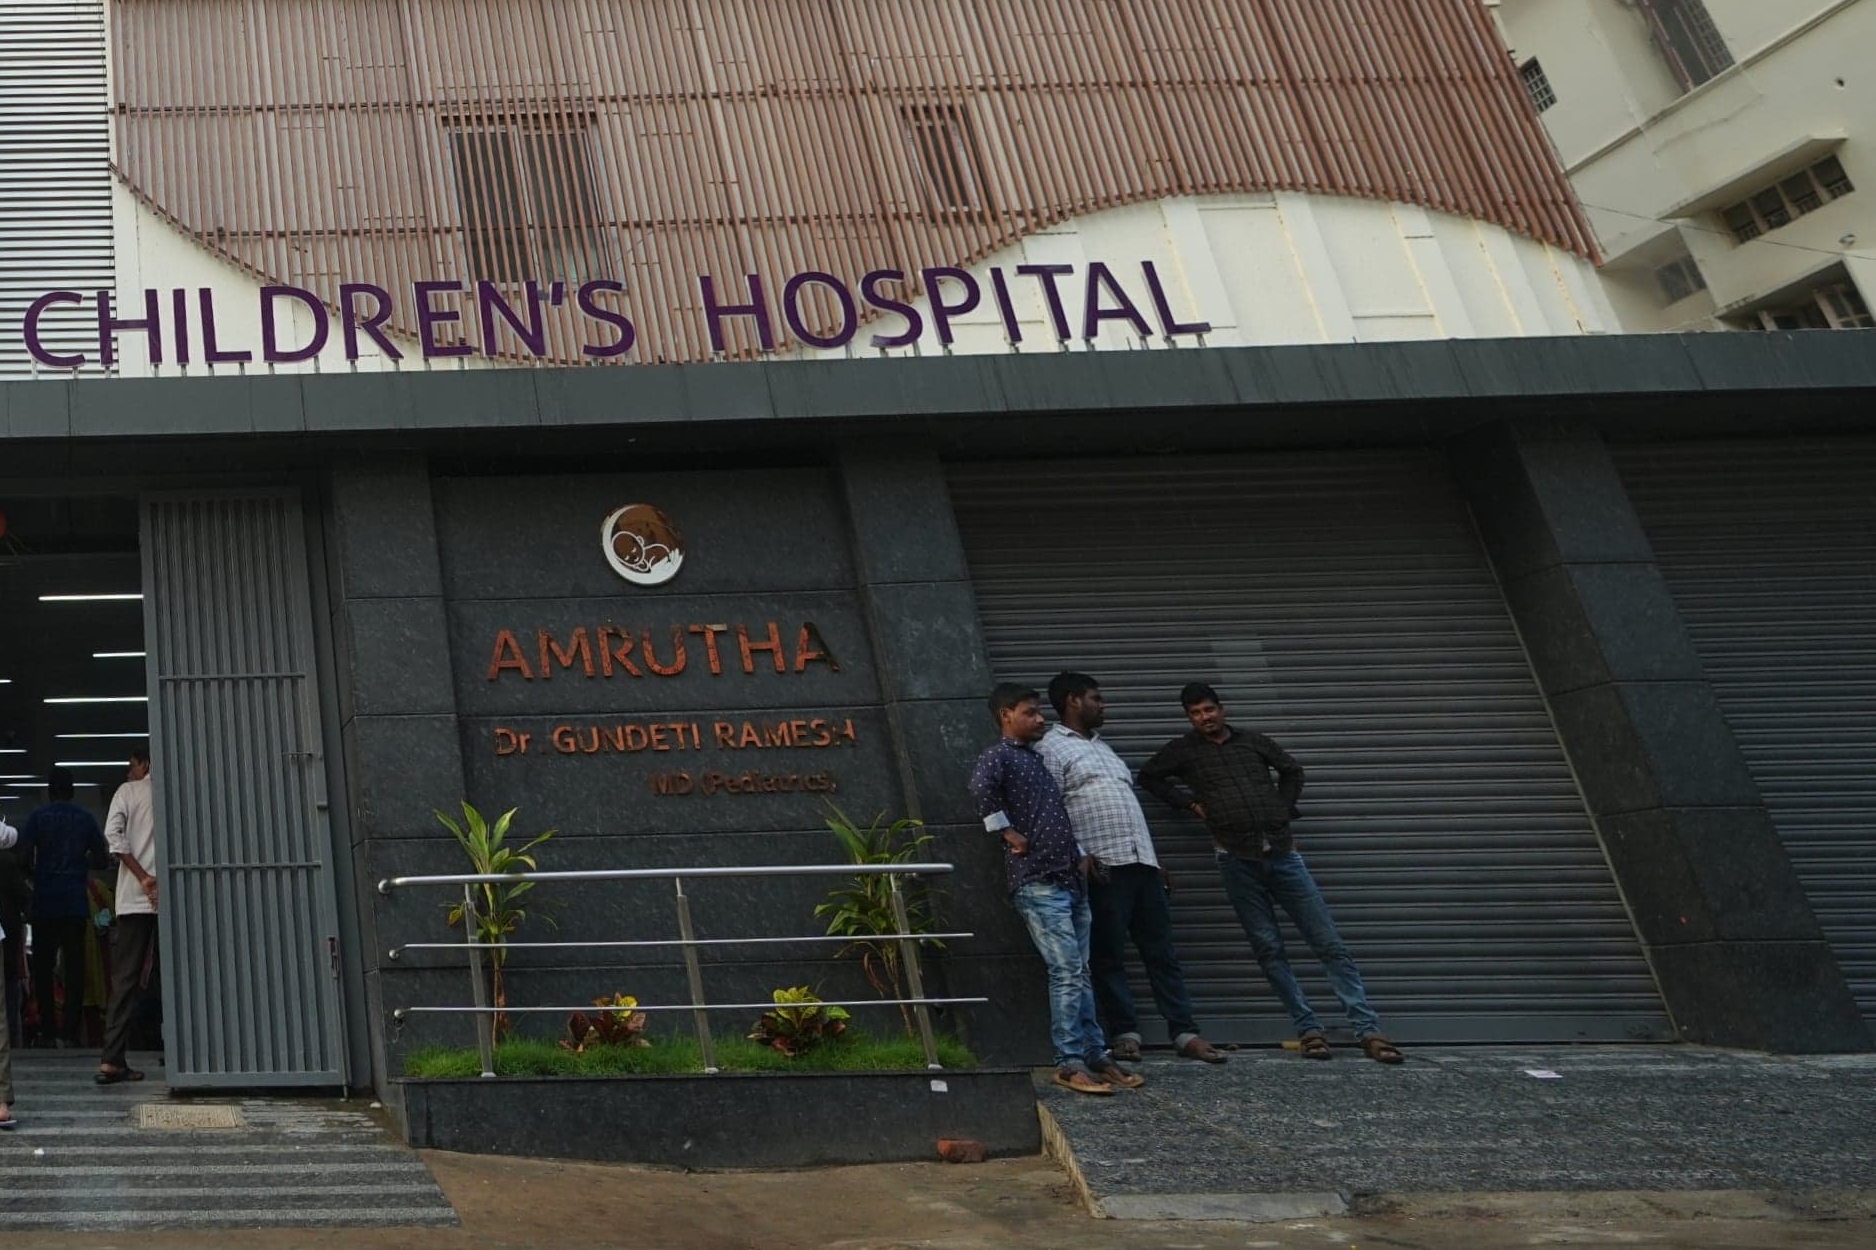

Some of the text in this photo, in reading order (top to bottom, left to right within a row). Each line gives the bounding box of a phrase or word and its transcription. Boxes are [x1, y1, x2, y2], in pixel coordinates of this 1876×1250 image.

[22, 280, 638, 367] CHILDREN'S
[699, 259, 1212, 349] HOSPITAL
[487, 621, 841, 681] AMRUTHA
[552, 723, 701, 754] GUNDETI
[714, 718, 856, 749] RAMESH
